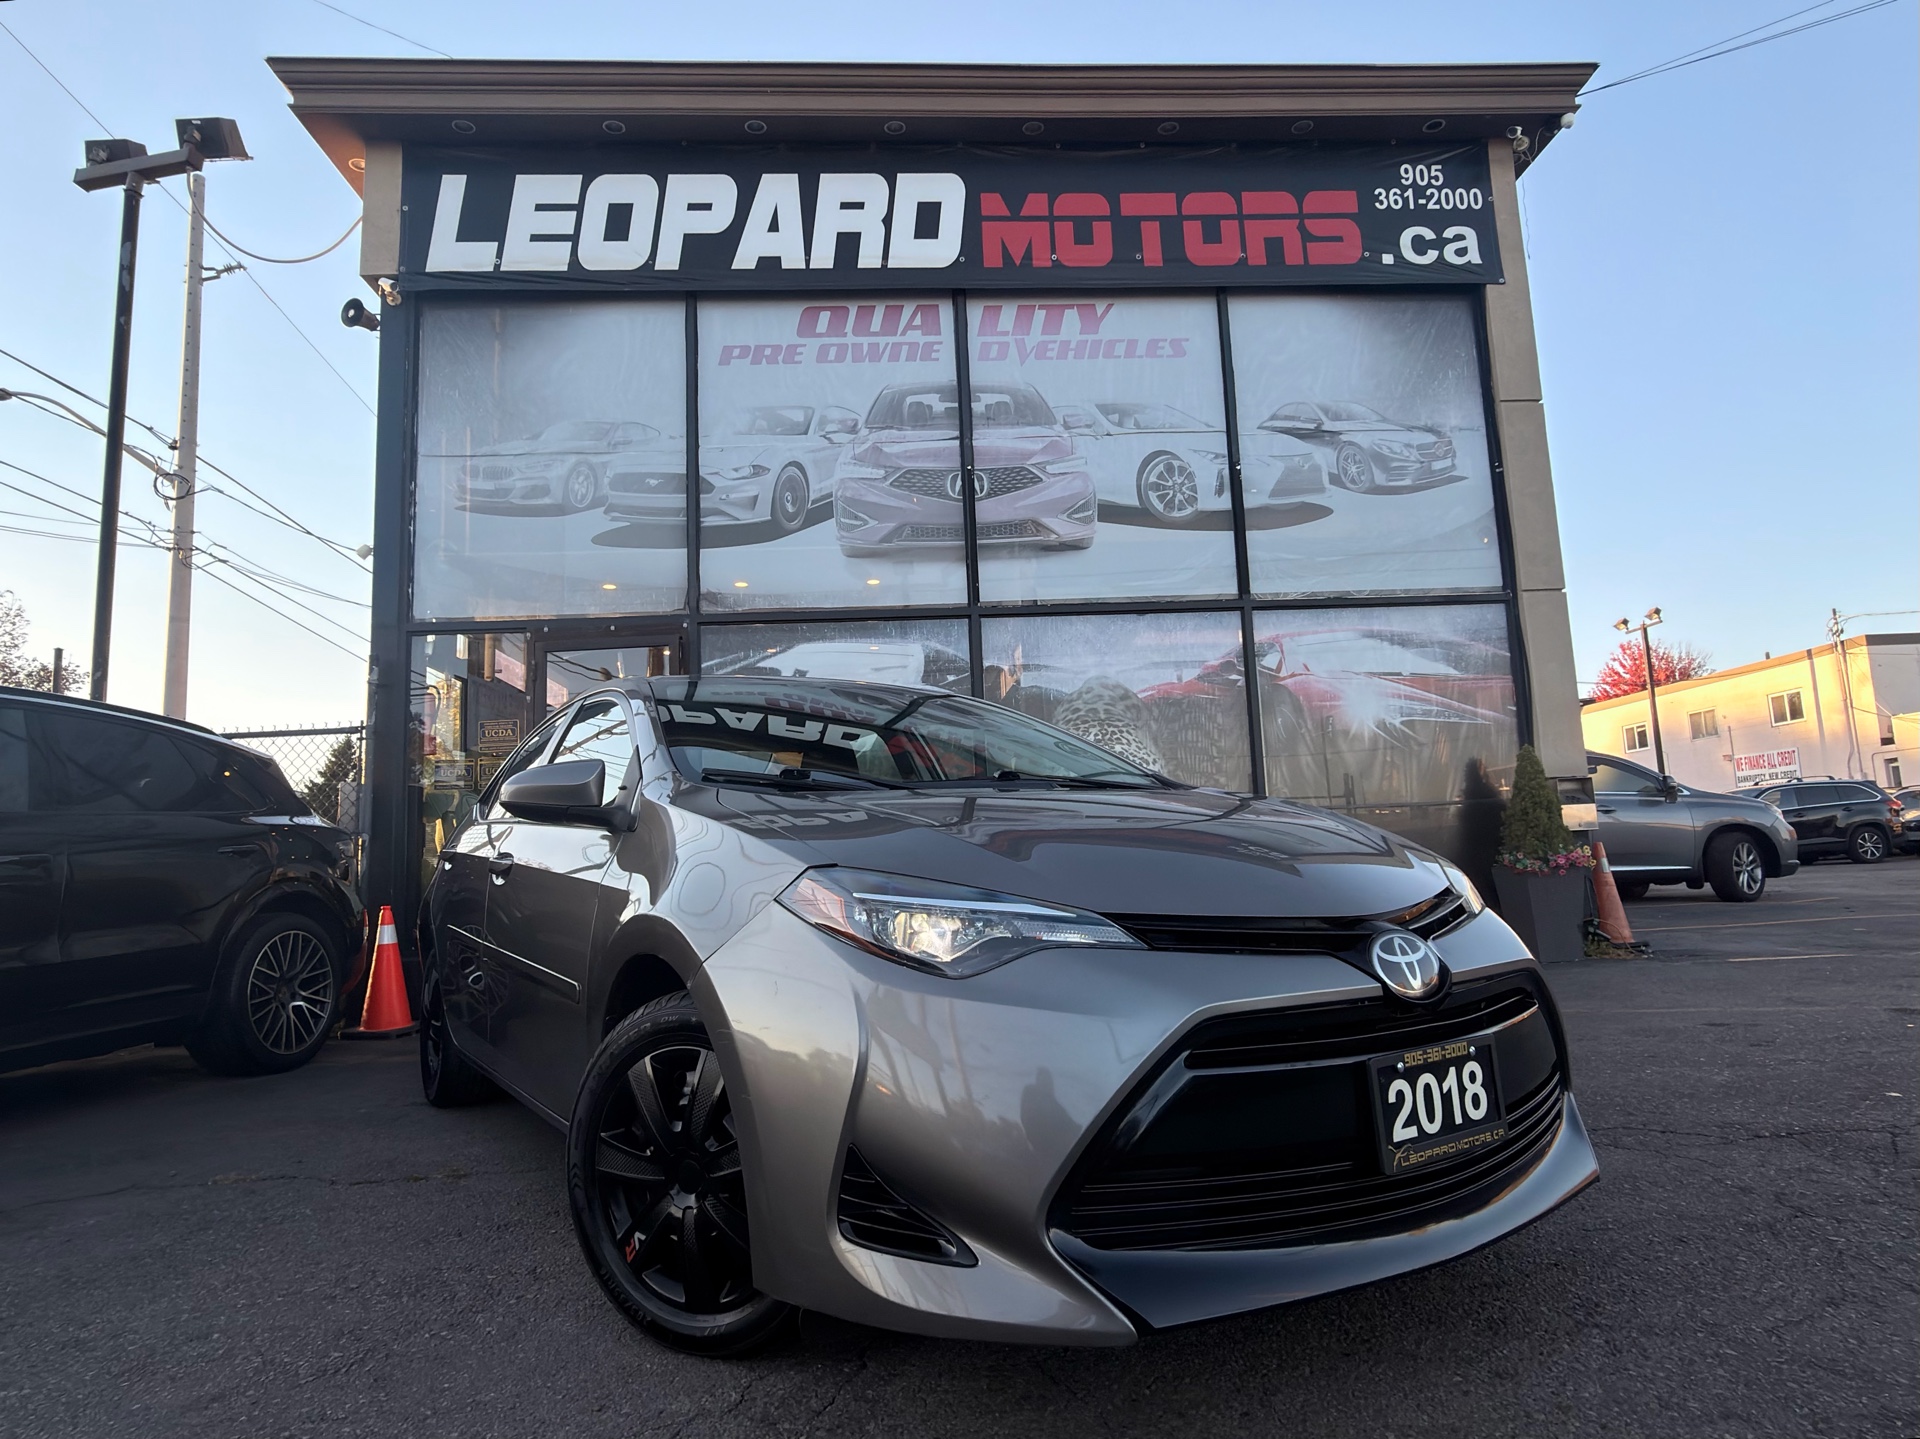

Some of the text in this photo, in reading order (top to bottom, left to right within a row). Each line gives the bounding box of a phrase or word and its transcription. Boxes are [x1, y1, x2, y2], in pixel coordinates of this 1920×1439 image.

[1399, 163, 1444, 187] 905
[1373, 187, 1484, 211] 361-2000
[424, 172, 1363, 273] LEOPARD MOTORS
[1381, 224, 1483, 266] .ca
[717, 343, 807, 367] PRE
[484, 728, 513, 738] UCDA
[1744, 754, 1766, 771] FINANCE
[1767, 753, 1777, 769] ALL
[1777, 750, 1797, 767] CREDIT
[440, 769, 468, 777] UCDA
[1403, 1041, 1468, 1067] 905-361-2000
[1387, 1060, 1488, 1143] 2018
